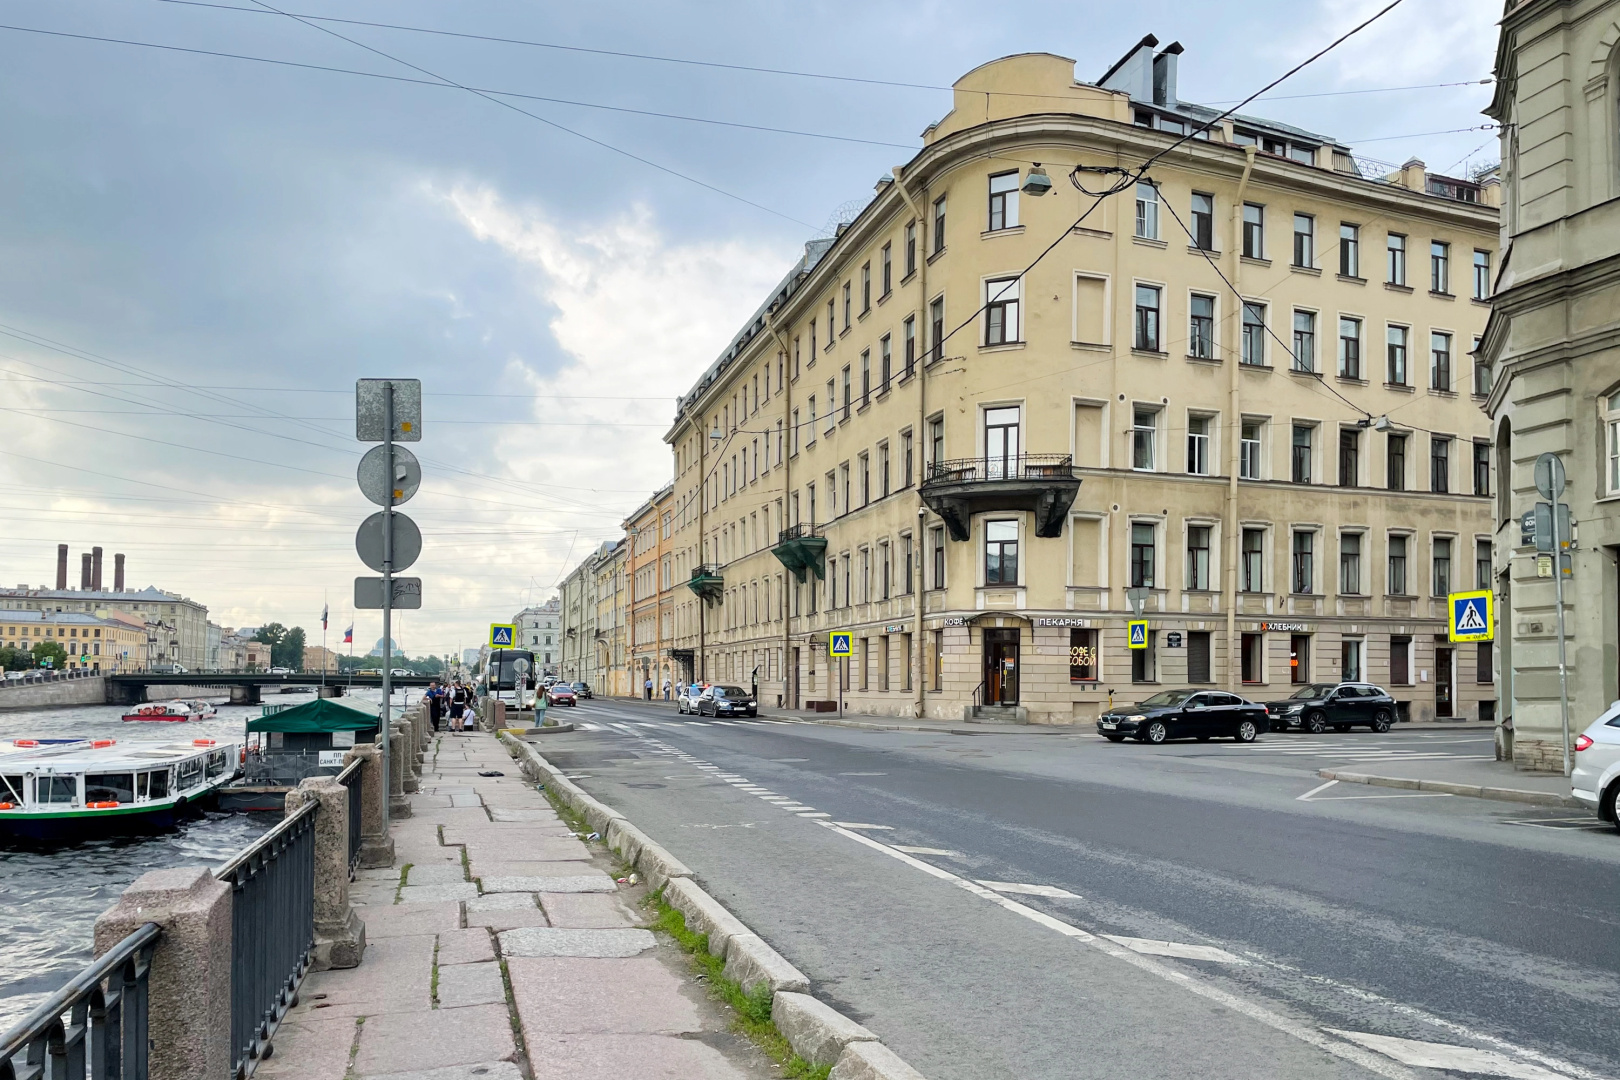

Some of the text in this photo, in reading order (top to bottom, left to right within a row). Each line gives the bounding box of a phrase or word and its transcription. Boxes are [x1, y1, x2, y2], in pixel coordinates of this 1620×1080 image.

[944, 618, 964, 626] КОФЕ
[1039, 618, 1083, 627] ПЕКАРНЯ
[1268, 622, 1302, 631] ХЛЕБНИК
